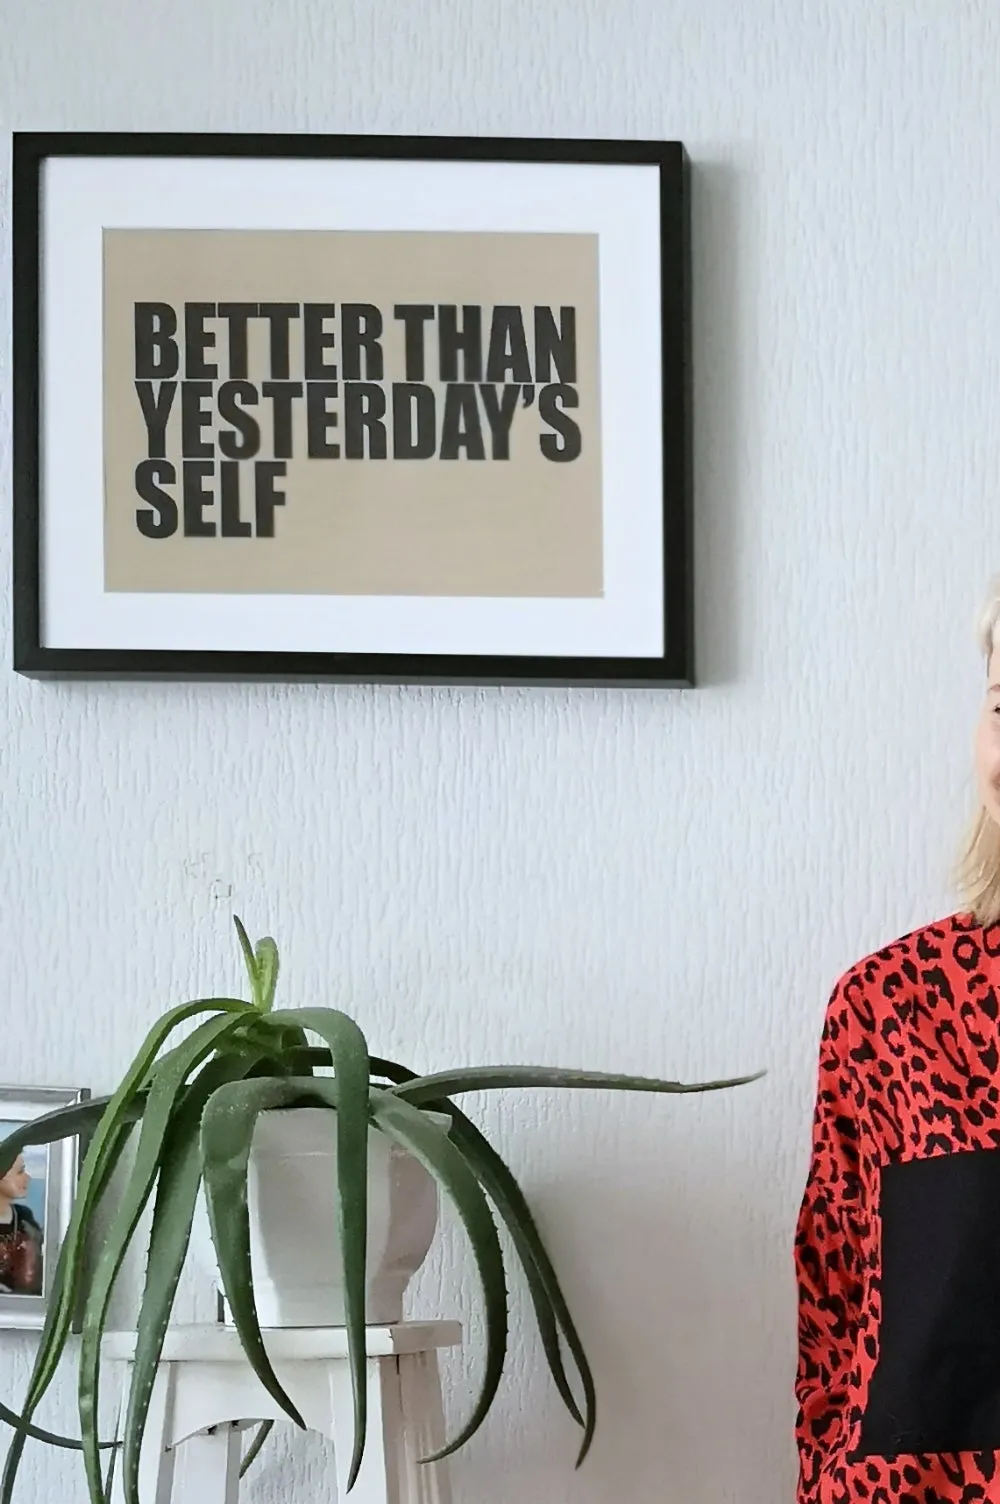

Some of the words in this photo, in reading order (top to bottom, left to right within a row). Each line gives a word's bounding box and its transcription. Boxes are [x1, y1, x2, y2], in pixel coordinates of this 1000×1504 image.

[134, 302, 384, 380] BETTER
[394, 304, 577, 383] THAN
[135, 380, 582, 462] YESTERDAY'S
[135, 459, 287, 538] SELF
